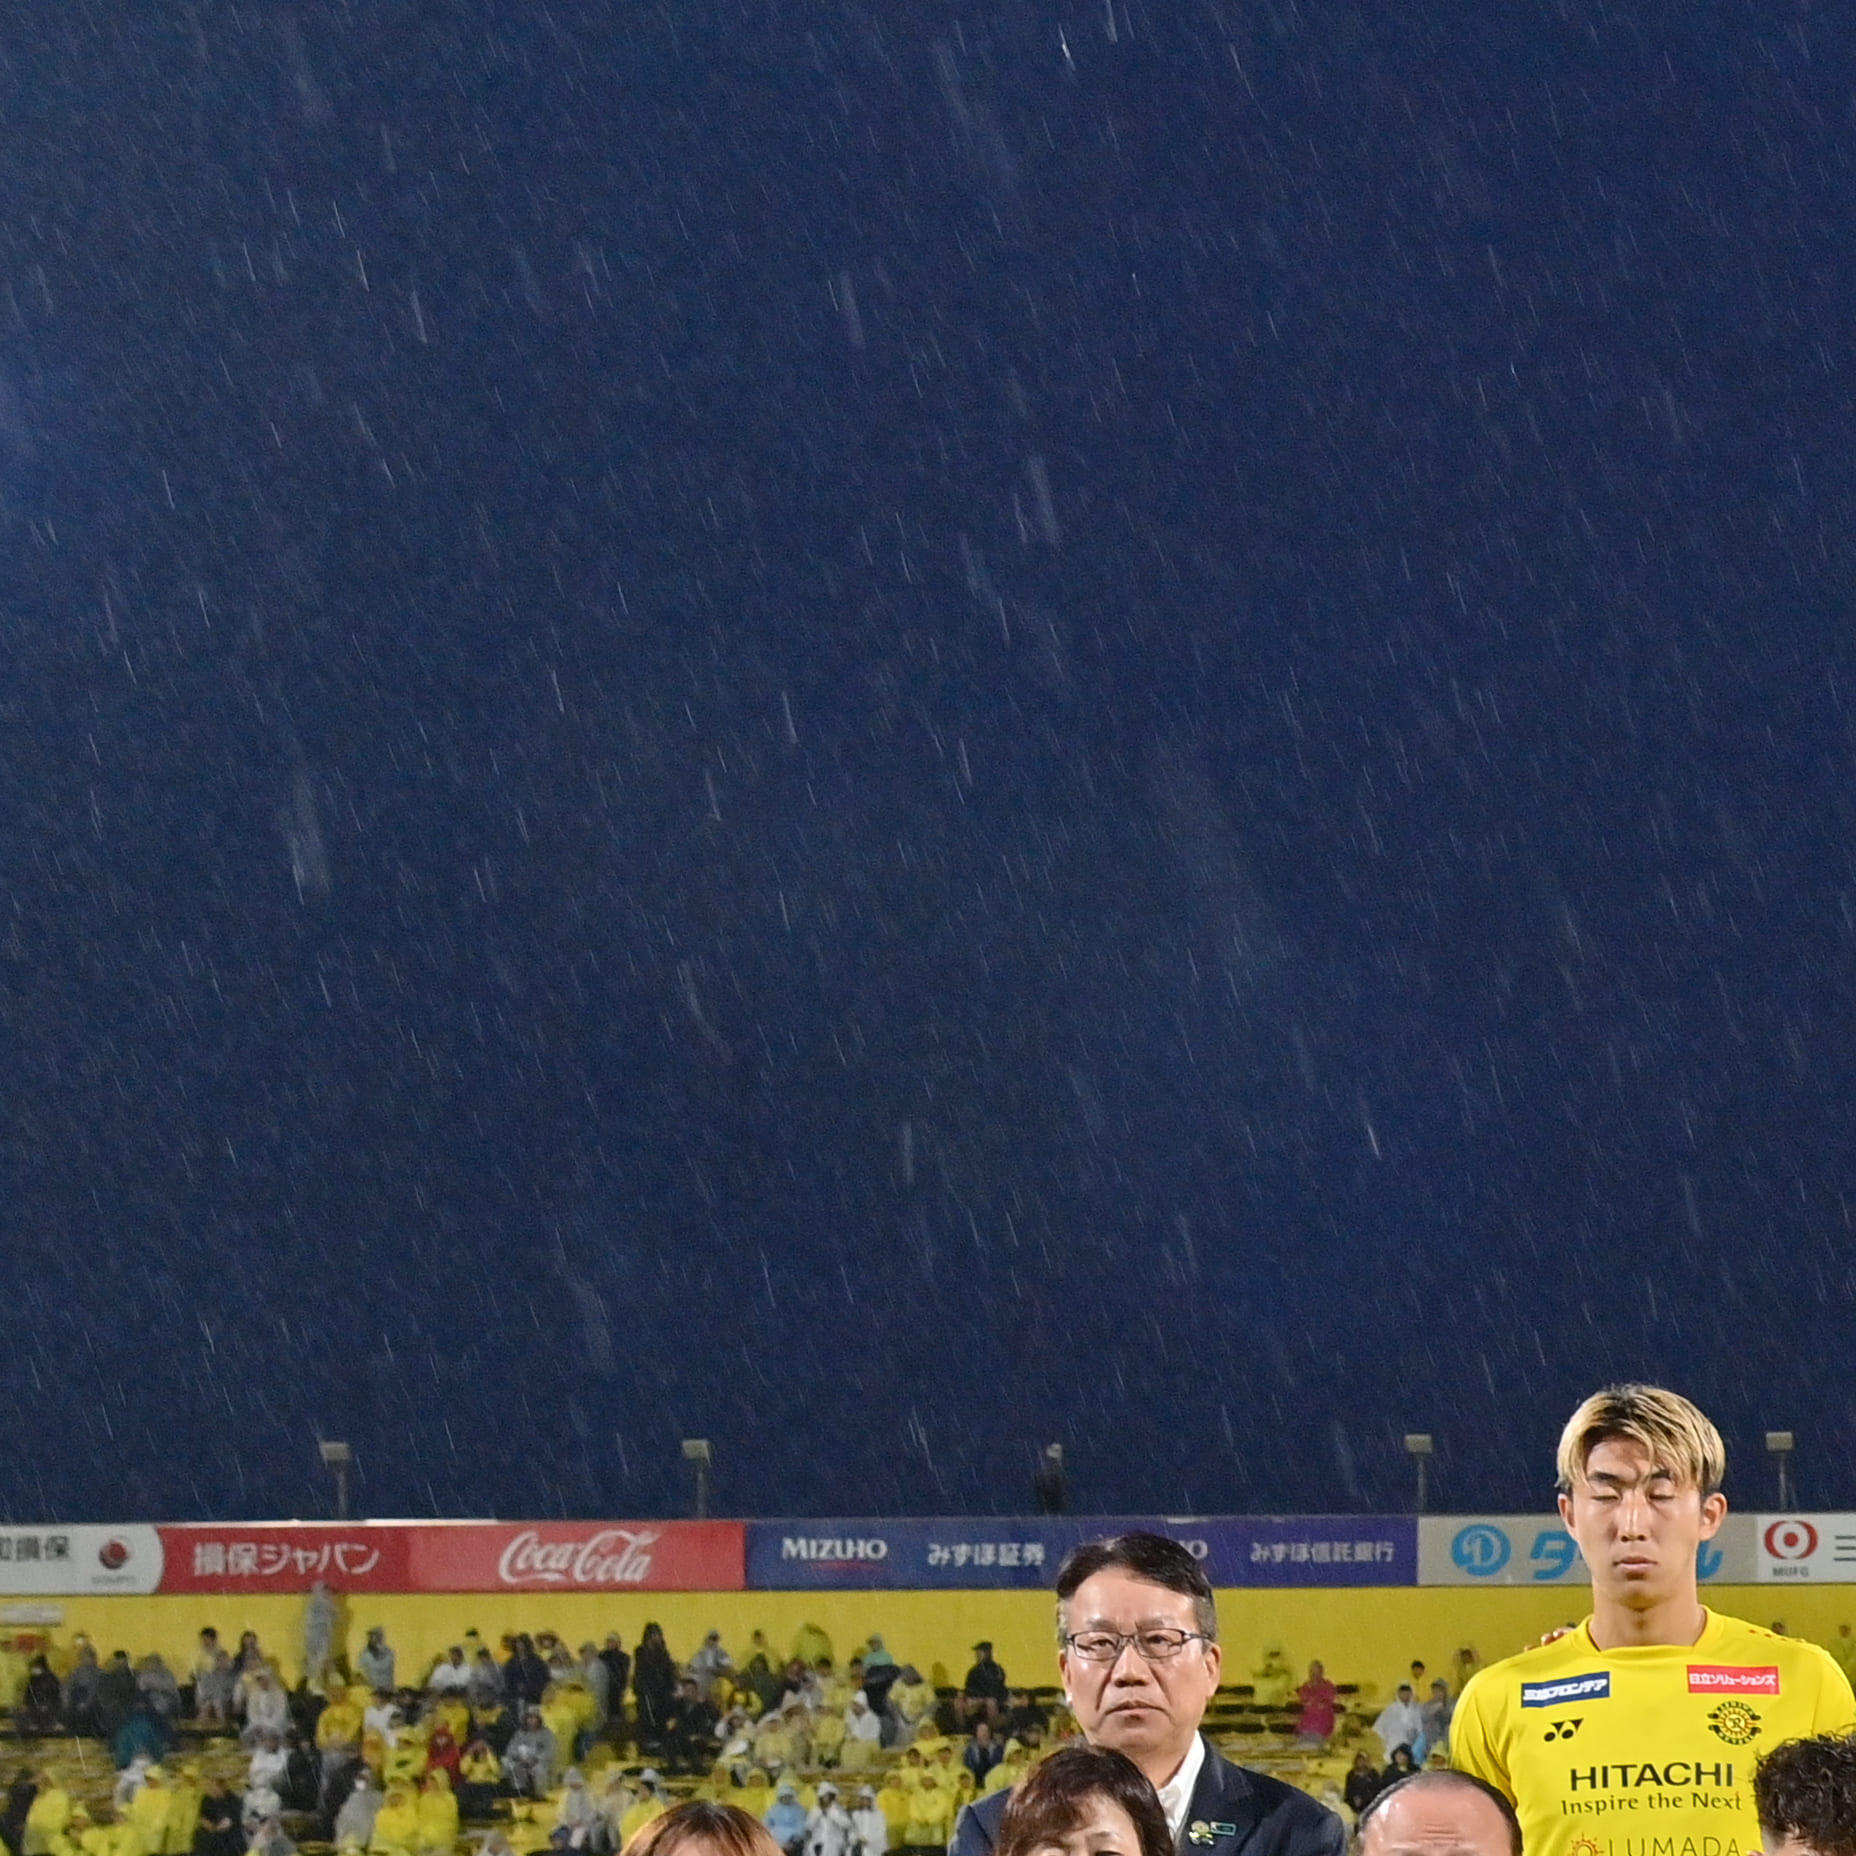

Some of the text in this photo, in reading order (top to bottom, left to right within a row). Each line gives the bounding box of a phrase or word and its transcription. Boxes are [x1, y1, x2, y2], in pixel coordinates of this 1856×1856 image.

[193, 1541, 380, 1577] 損保ジャパン
[499, 1529, 662, 1583] Coca-Cola
[781, 1536, 888, 1562] MIZUHO
[927, 1541, 1046, 1568] みずほ証券
[1249, 1539, 1395, 1565] みずほ信託銀行
[1570, 1761, 1733, 1792] HITACHI
[1561, 1791, 1743, 1817] Inspire the Next
